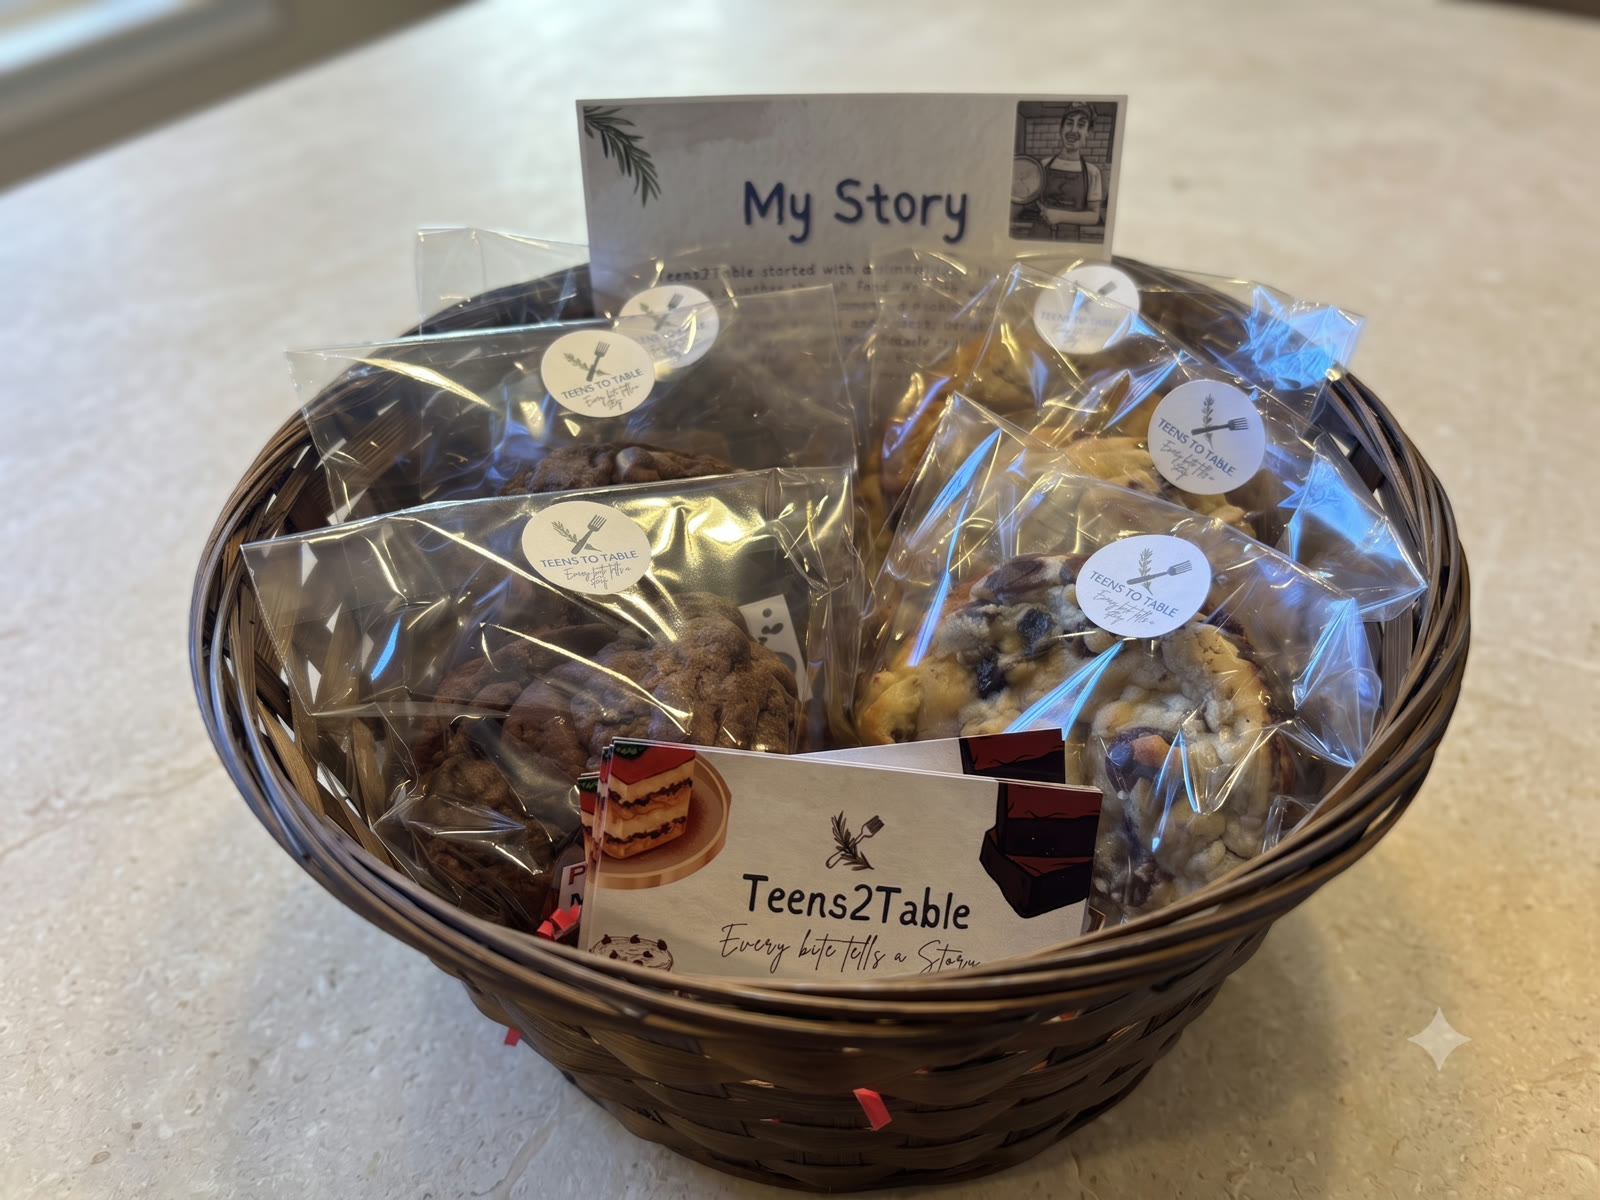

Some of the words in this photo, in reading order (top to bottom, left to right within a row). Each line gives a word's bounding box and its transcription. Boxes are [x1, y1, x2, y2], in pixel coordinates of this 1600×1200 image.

[744, 180, 811, 244] My
[834, 178, 968, 244] Story
[762, 262, 816, 278] started
[823, 262, 854, 276] with
[561, 384, 595, 399] TEENS
[594, 379, 611, 389] TO
[611, 368, 644, 384] TABLE
[1158, 418, 1189, 444] TEENS
[1188, 439, 1205, 454] TO
[1204, 449, 1236, 477] TABLE
[540, 557, 579, 568] TEENS
[580, 555, 599, 564] TO
[600, 550, 639, 562] TABLE
[1090, 570, 1125, 593] TEENS
[1125, 588, 1142, 602] TO
[1141, 596, 1179, 618] TABLE
[742, 873, 971, 930] Teens2Table
[719, 923, 791, 973] Every
[798, 928, 837, 971] bite
[840, 934, 886, 973] tells
[893, 950, 907, 963] a
